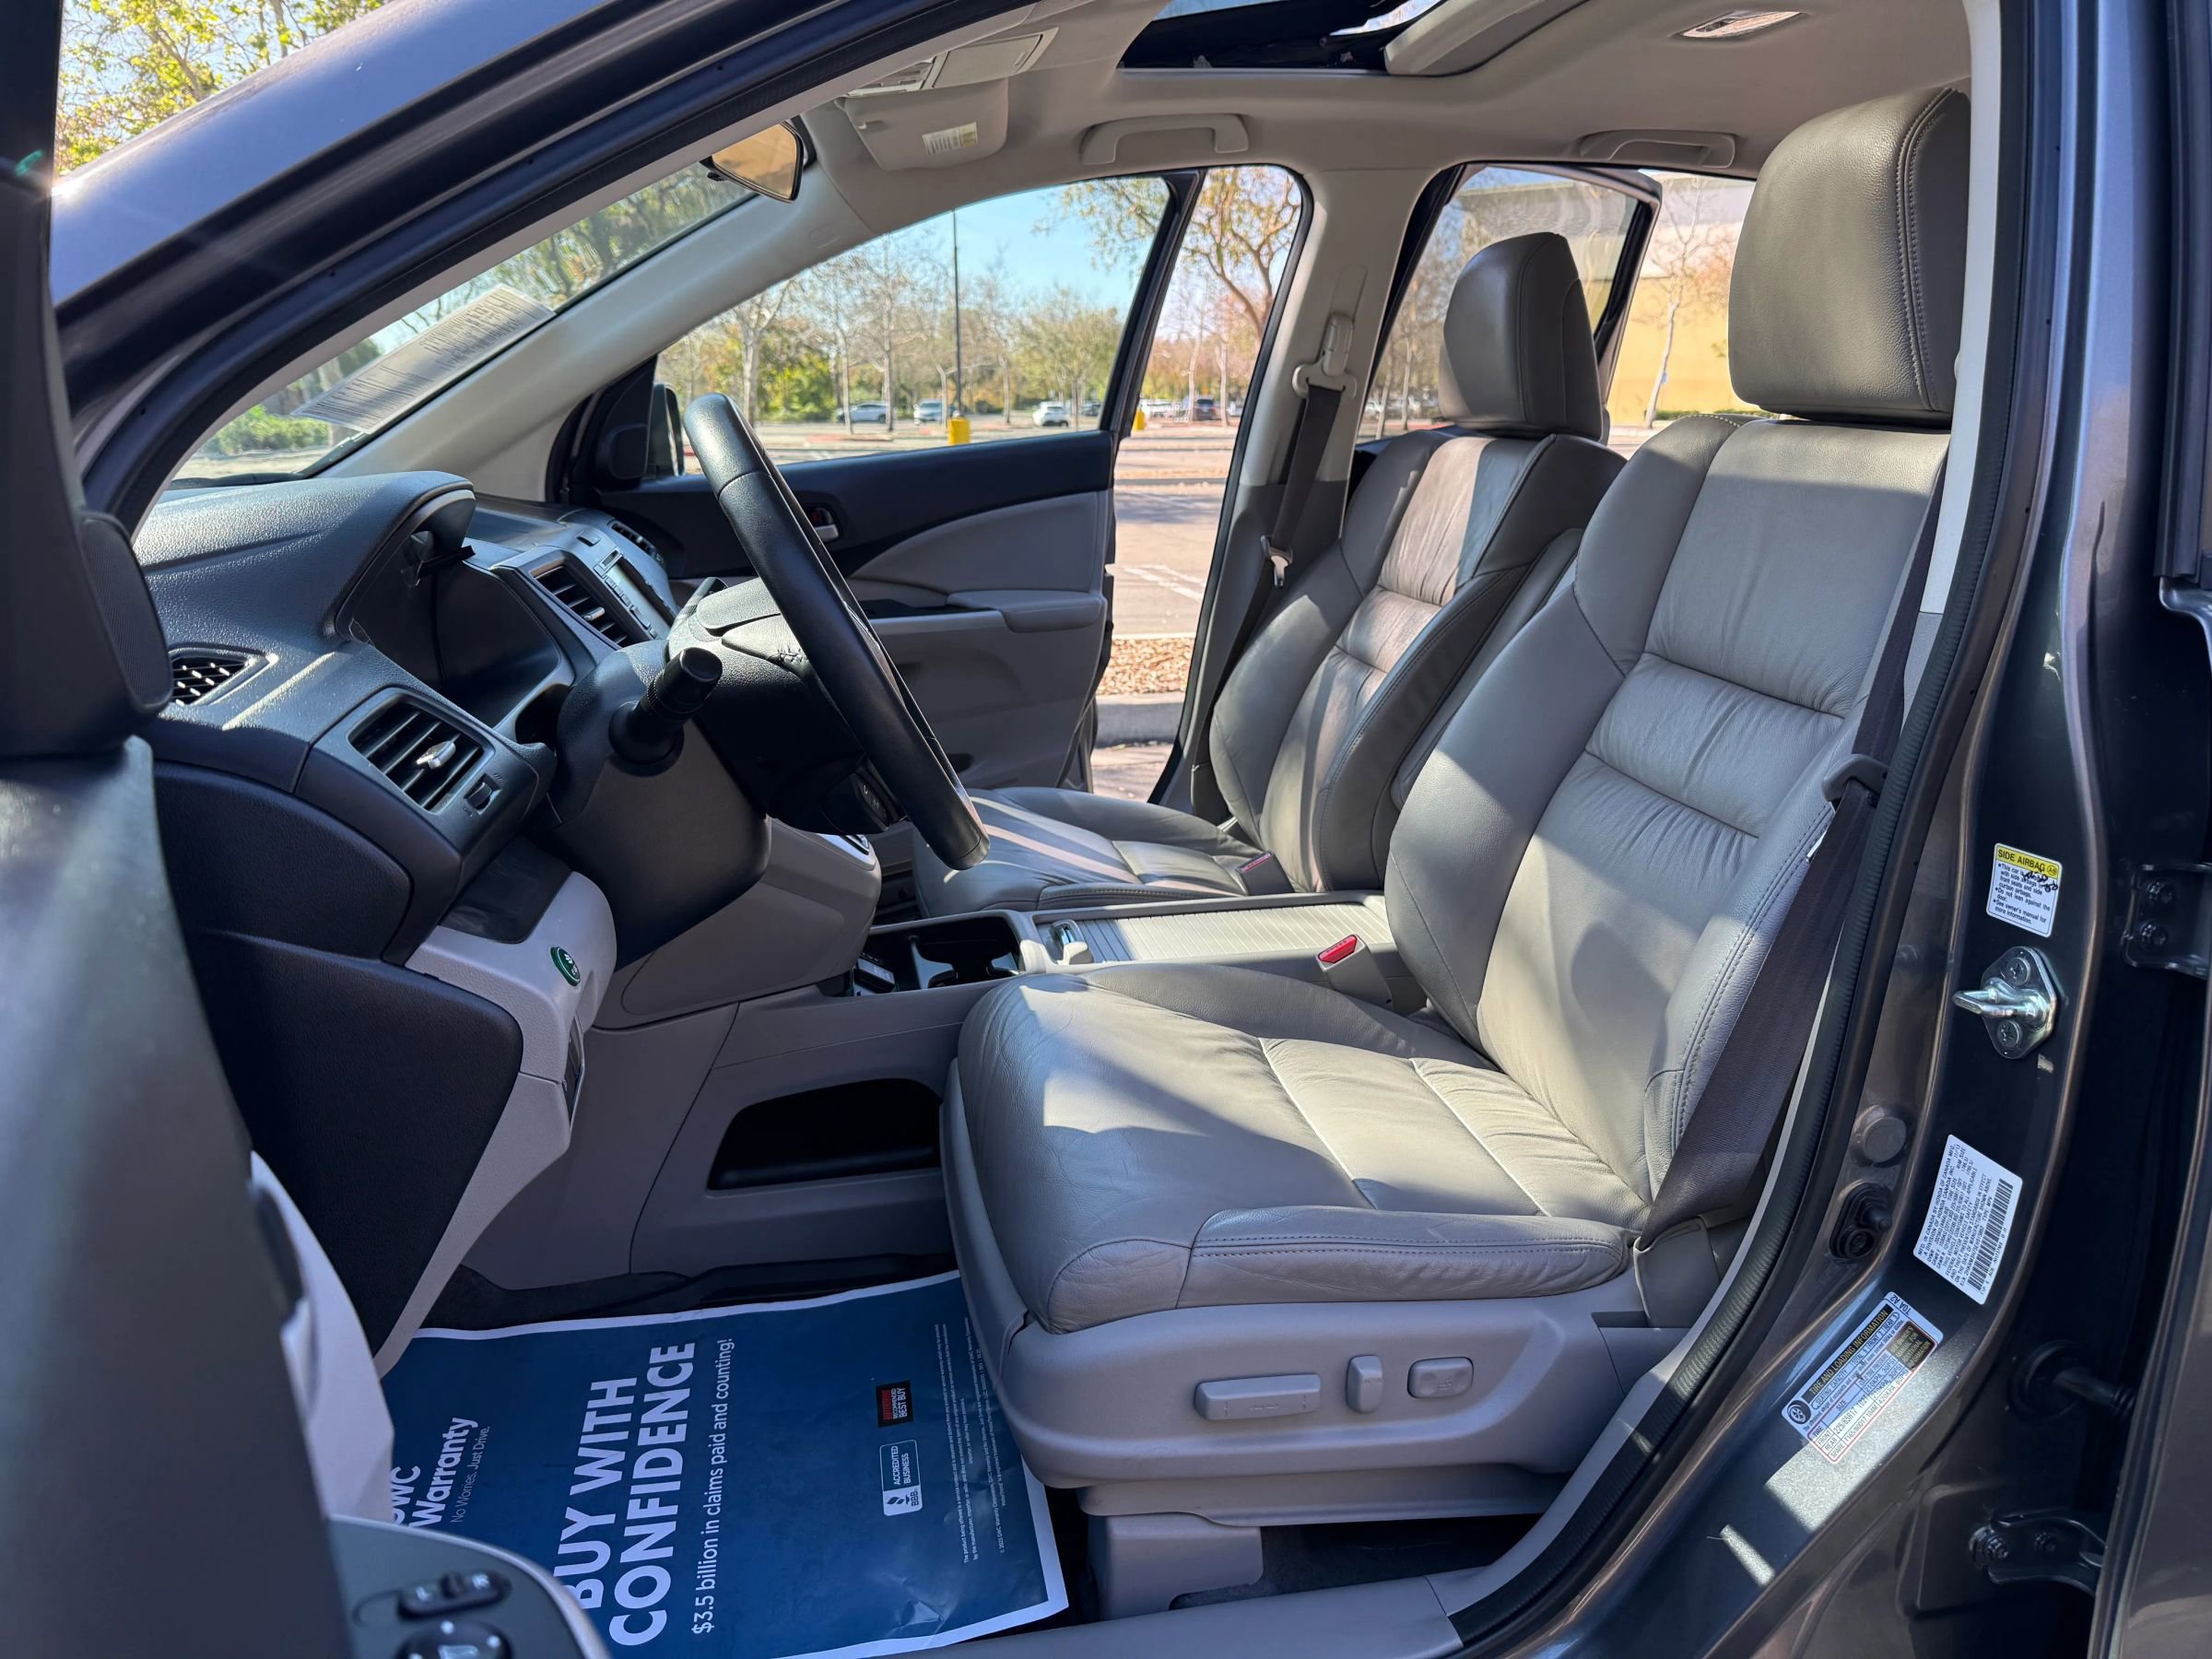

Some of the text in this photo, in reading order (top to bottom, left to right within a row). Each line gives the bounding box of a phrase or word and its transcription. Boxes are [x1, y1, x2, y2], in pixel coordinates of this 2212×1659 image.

[1997, 849, 2015, 861] SIDE
[2017, 855, 2045, 871] AIRBAG
[1925, 1214, 1936, 1235] CANADA
[1935, 1187, 1943, 1205] HONDA
[1942, 1158, 1951, 1179] CANADA
[1942, 1177, 1951, 1198] CANADA
[1934, 1218, 1939, 1227] OF
[1936, 1199, 1946, 1218] HONDA
[1924, 1225, 1936, 1251] DIVISION
[1969, 1211, 1982, 1244] MANUFACTURE
[1808, 1310, 1888, 1394] TIRE AND LOADING INFORMATION
[896, 1387, 907, 1417] BEST BUY
[1815, 1387, 1831, 1405] SEATING
[1830, 1369, 1848, 1388] CAPACITY
[1812, 1425, 1824, 1437] TIRE
[1835, 1399, 1847, 1411] SIZE
[1833, 1406, 1857, 1434] 225/65R17
[1817, 1430, 1831, 1445] FRONT
[1824, 1437, 1837, 1451] REAR
[1830, 1442, 1844, 1457] SPARE
[409, 1417, 478, 1526] Warranty
[450, 1425, 490, 1522] No Worries. Just Drive.
[890, 1445, 900, 1484] ACCREDITED
[901, 1453, 911, 1483] BUSINESS
[553, 1377, 637, 1609] BUY WITH
[608, 1342, 695, 1646] CONFIDENCE
[690, 1337, 735, 1633] $3.5 billion in claims paid and counting!
[910, 1490, 919, 1506] BBB
